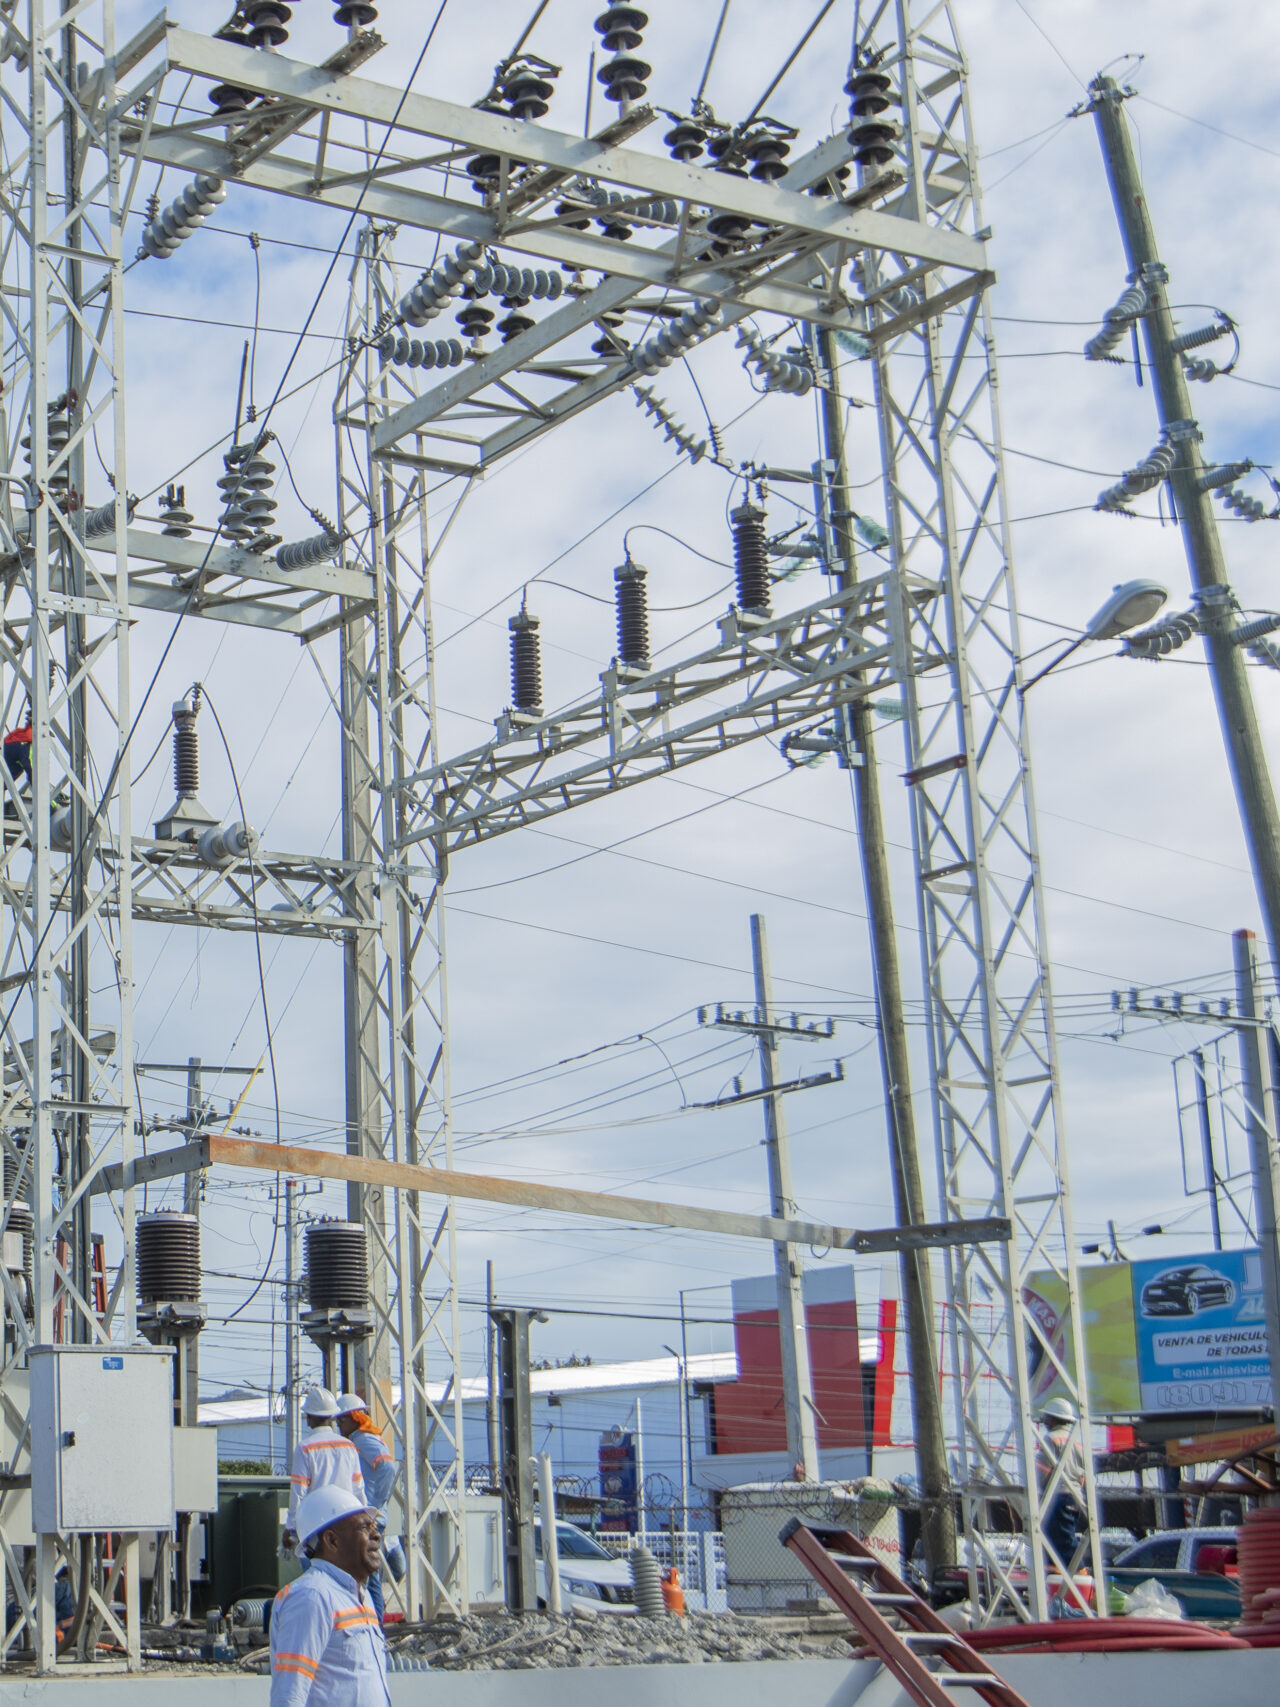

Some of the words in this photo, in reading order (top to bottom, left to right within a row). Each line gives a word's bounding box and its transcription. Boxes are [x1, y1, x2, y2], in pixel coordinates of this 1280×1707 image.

[1158, 1336, 1194, 1347] VENTA
[1196, 1334, 1212, 1344] DE
[1207, 1347, 1224, 1357] DE
[1226, 1345, 1263, 1355] TODAS
[1157, 1382, 1247, 1408] (809)
